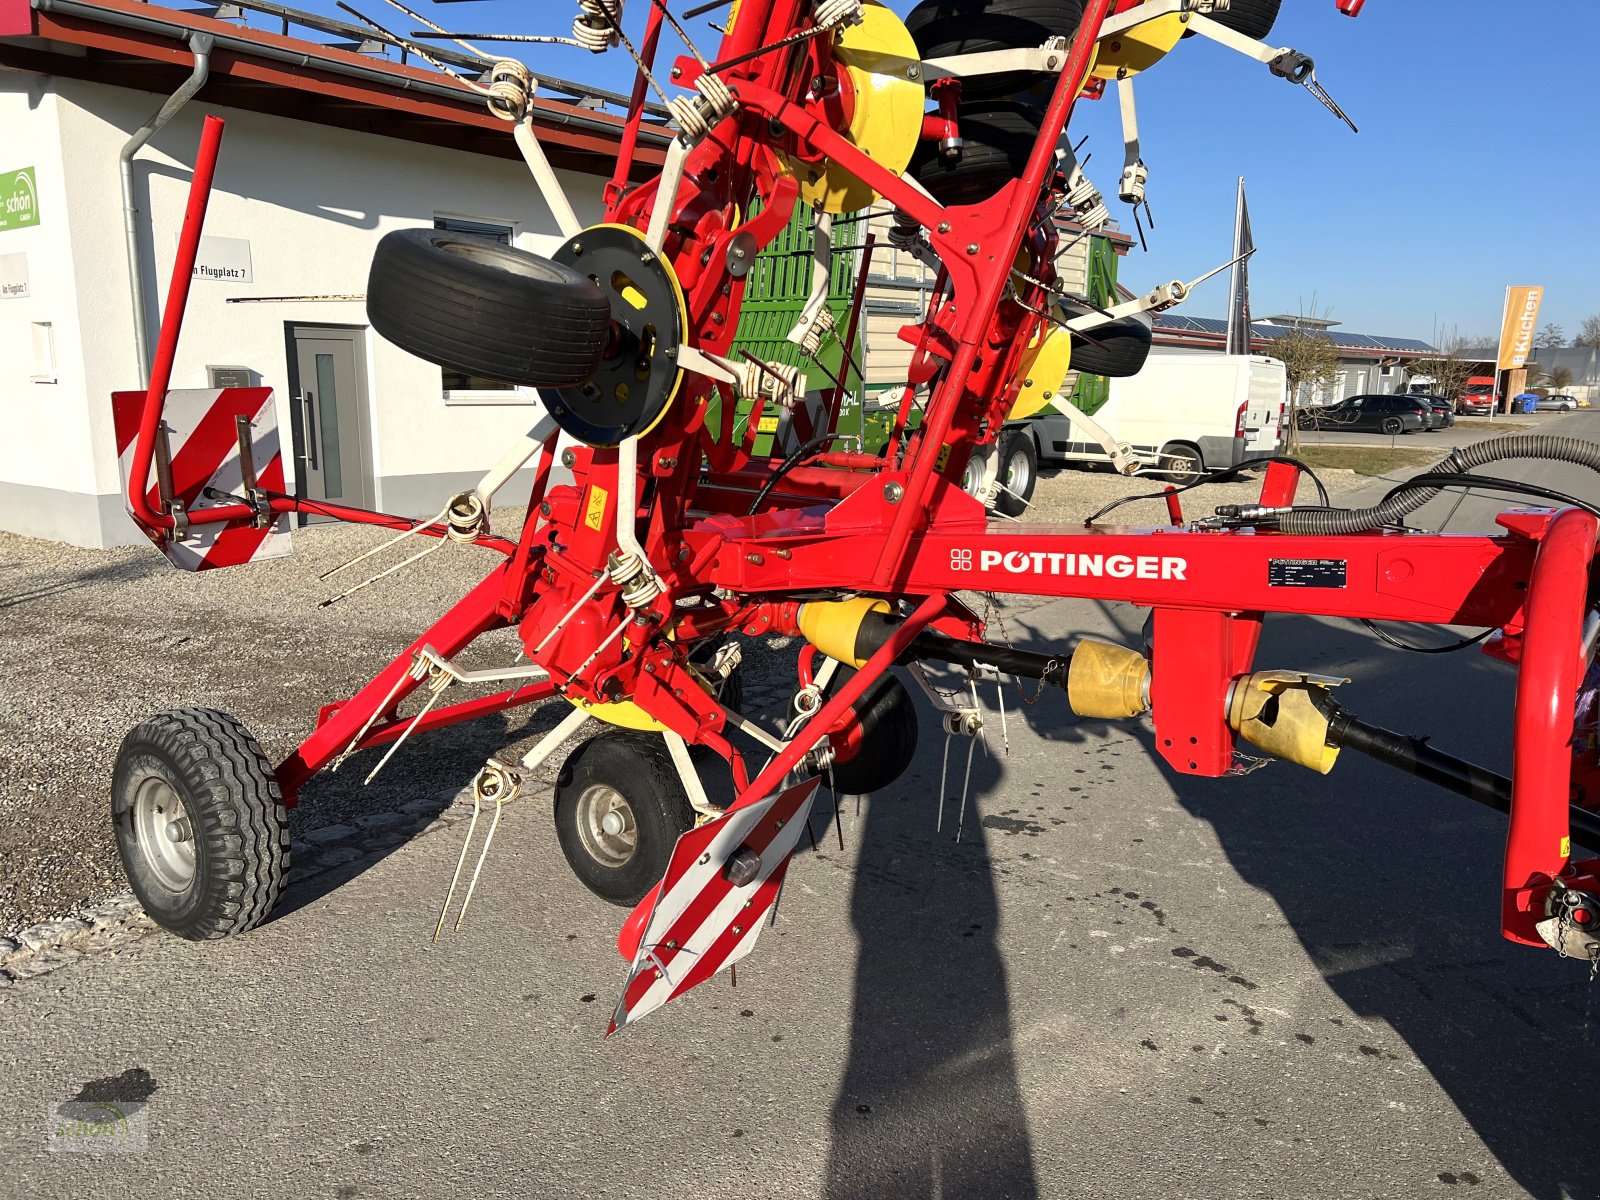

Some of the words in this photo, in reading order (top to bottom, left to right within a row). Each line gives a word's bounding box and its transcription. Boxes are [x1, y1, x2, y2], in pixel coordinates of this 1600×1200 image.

[6, 190, 30, 214] schön
[200, 265, 239, 279] Flugplatz
[241, 269, 246, 278] 7
[1515, 290, 1539, 352] Küchen
[980, 550, 1188, 580] PÖTTINGER
